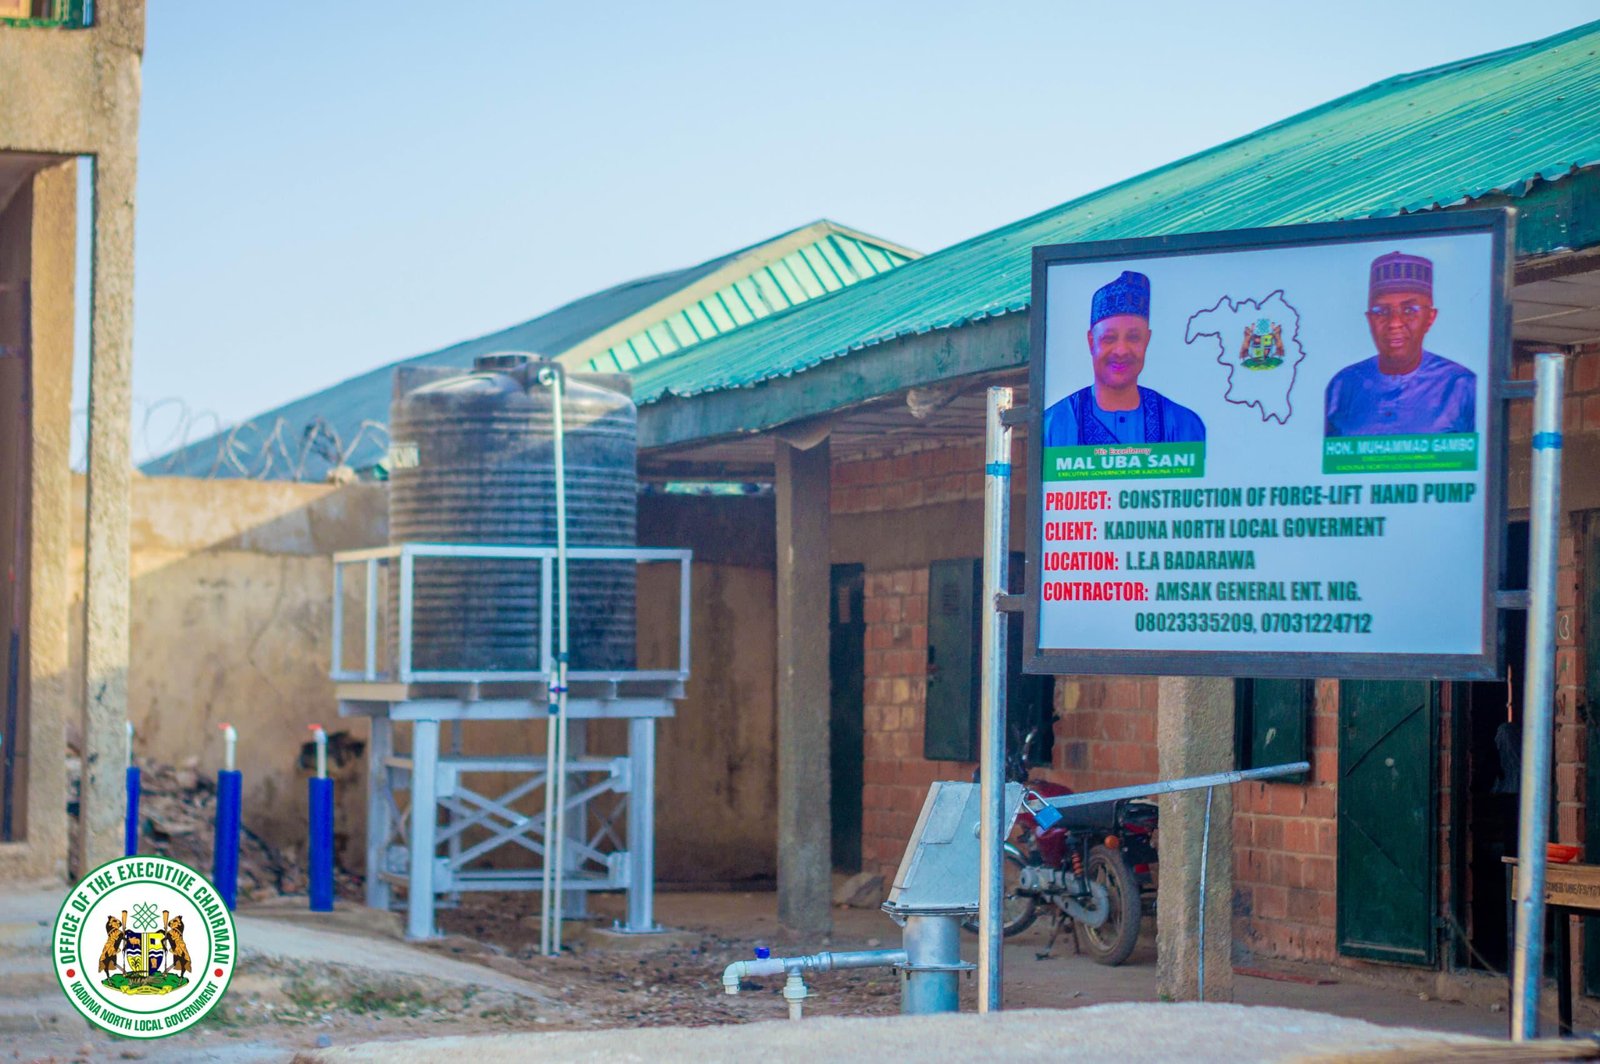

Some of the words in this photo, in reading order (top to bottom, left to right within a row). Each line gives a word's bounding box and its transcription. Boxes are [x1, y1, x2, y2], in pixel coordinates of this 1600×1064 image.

[1325, 441, 1354, 455] HON.
[1431, 438, 1475, 452] GAMBO
[1056, 457, 1096, 470] MAL
[1101, 455, 1141, 469] UBA
[1147, 453, 1196, 467] SANI
[1046, 491, 1111, 511] PROJECT:
[1118, 488, 1242, 509] CONSTRUCTION
[1246, 487, 1267, 507] OF
[1270, 485, 1362, 506] FORCE-LIFT
[1370, 484, 1419, 504] HAND
[1423, 482, 1476, 503] PUMP
[1045, 521, 1097, 541] CLIENT:
[1104, 520, 1169, 540] KADUNA
[1171, 519, 1226, 539] NORTH
[1229, 518, 1279, 538] LOCAL
[1283, 516, 1386, 538] GOVERMENT
[1044, 551, 1119, 571] LOCATION:
[1126, 551, 1160, 570] L.E.A
[1163, 550, 1256, 570] BADARAWA
[1043, 581, 1149, 601] CONTRACTOR:
[1155, 581, 1213, 601] AMSAK
[1216, 581, 1287, 601] GENERAL
[1290, 581, 1323, 601] ENT.
[1326, 581, 1362, 601] NIG.
[1134, 612, 1258, 634] 08023335209,
[1260, 612, 1373, 634] 07031224712
